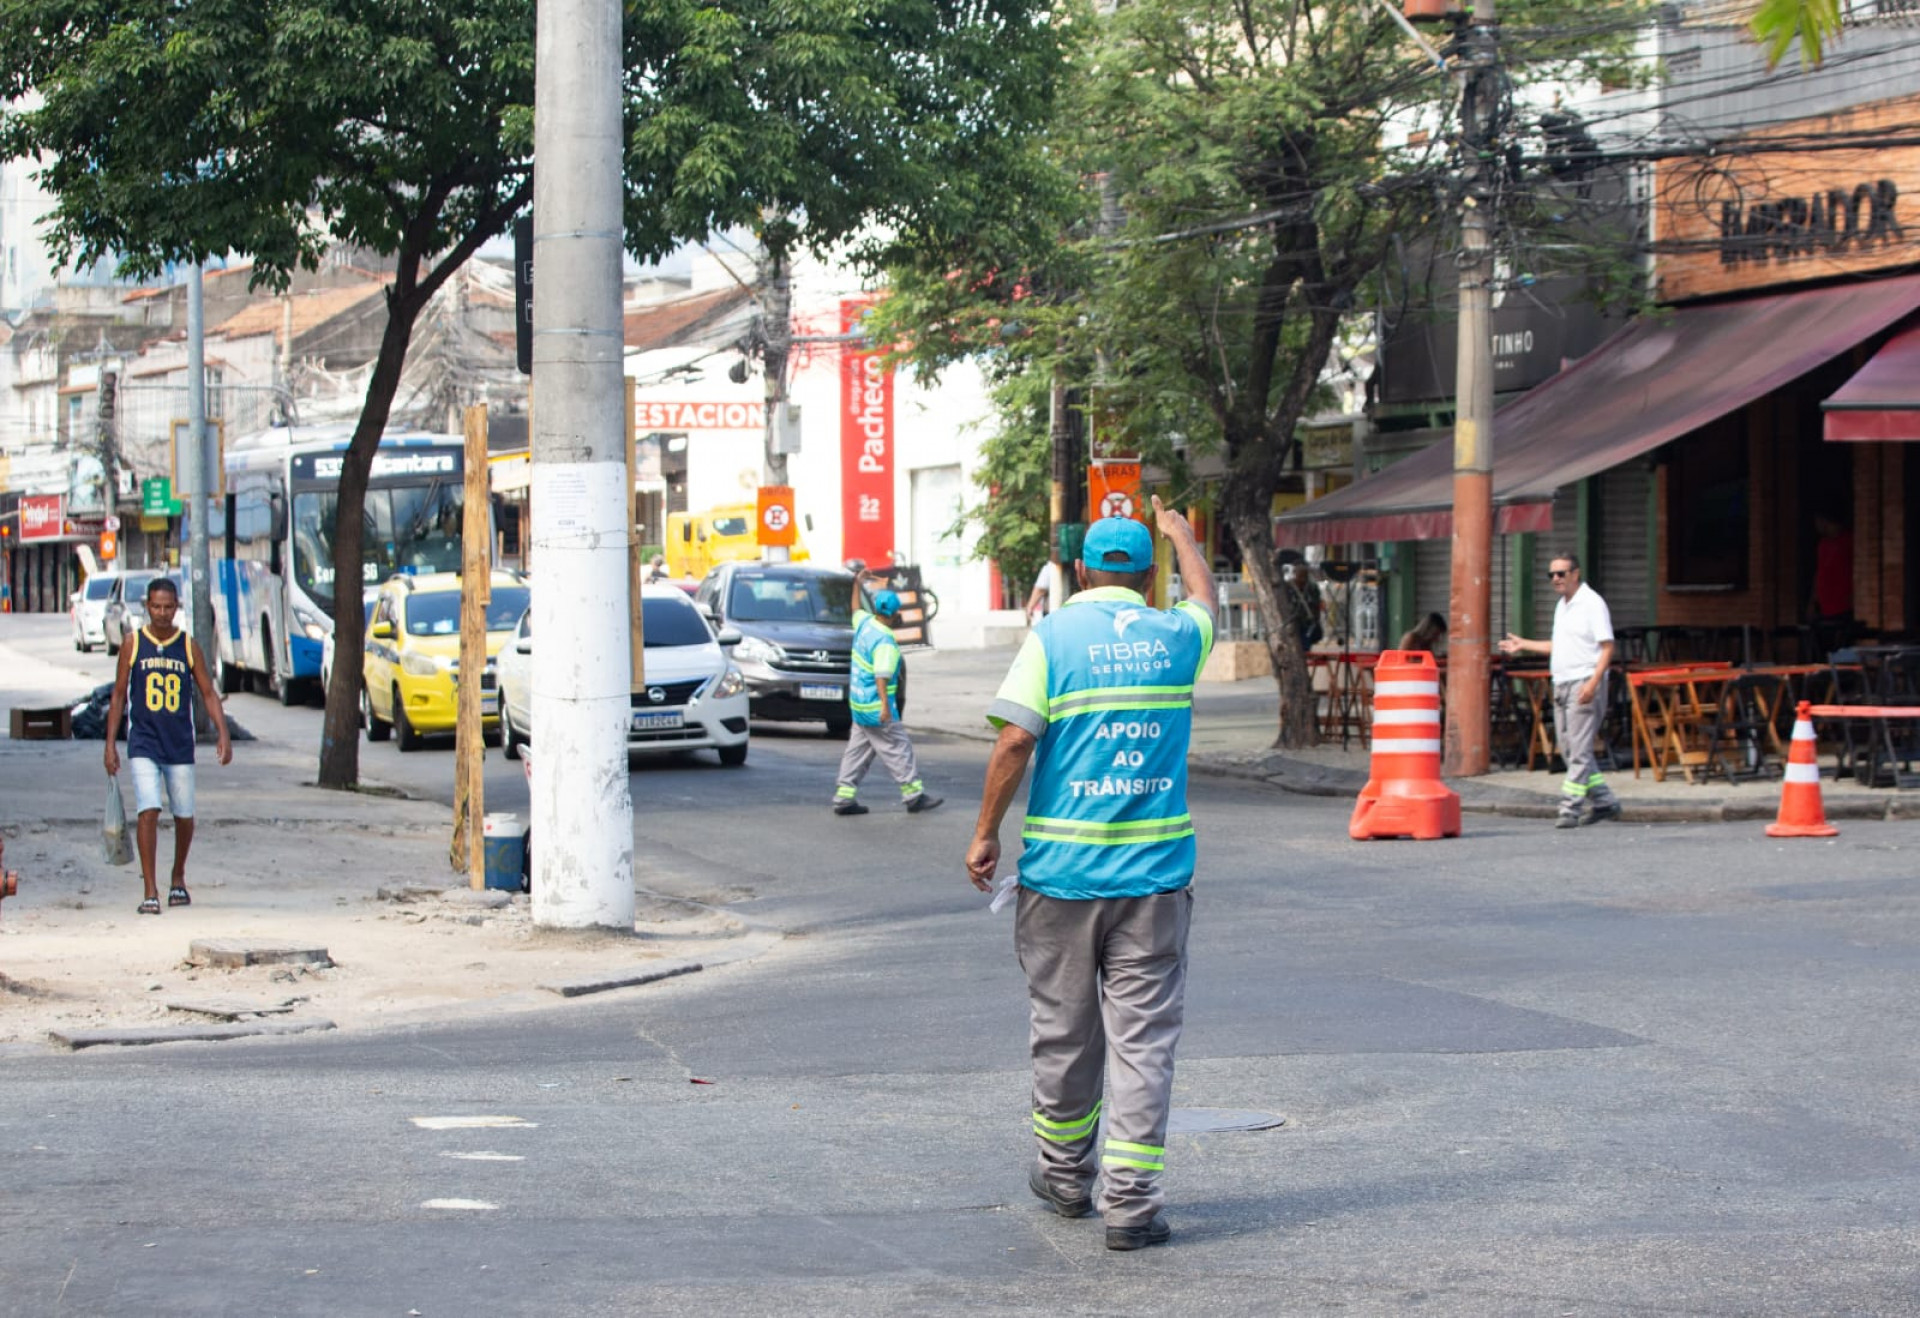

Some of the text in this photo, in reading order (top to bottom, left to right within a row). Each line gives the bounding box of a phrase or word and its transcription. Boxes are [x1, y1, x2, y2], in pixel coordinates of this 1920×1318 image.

[857, 355, 884, 473] Pacheco
[1088, 639, 1169, 662] FIBRA
[1092, 659, 1171, 674] SERVIÇOS
[146, 672, 181, 712] 68
[1094, 722, 1161, 740] APOIO
[1112, 750, 1144, 767] AO
[1070, 776, 1173, 797] TRÂNSITO
